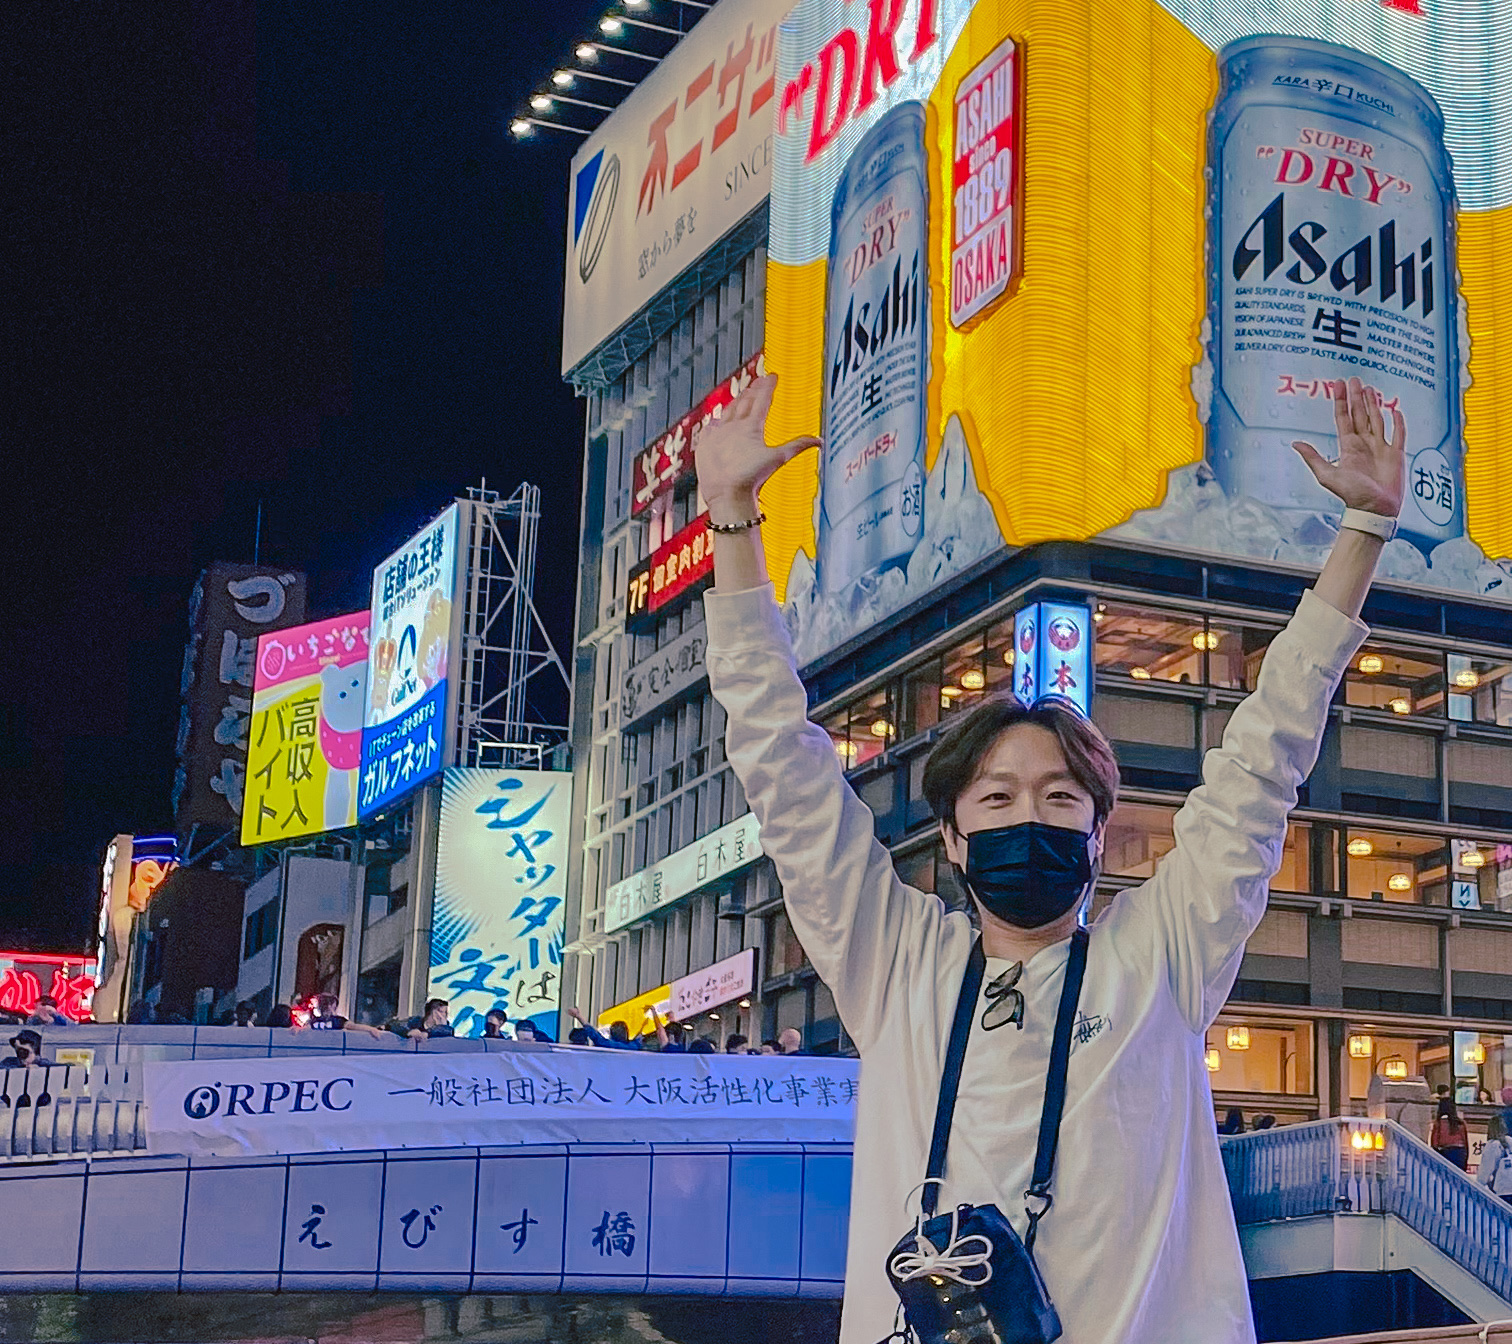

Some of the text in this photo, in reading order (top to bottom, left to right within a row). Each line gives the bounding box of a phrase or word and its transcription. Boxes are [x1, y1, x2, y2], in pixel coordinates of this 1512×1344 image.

[954, 58, 1014, 163] ASAHI
[1272, 74, 1397, 115] KARA 辛口 KUCHI
[969, 134, 997, 175] since
[1298, 126, 1377, 163] SUPER
[862, 196, 895, 233] SUPER
[954, 146, 1013, 246] 1889
[953, 219, 1008, 315] OSAKA
[1232, 192, 1435, 320] Asahi
[832, 248, 920, 398] Asahi
[1279, 289, 1296, 298] DRY
[1307, 292, 1342, 306] BREWED
[1344, 300, 1367, 312] WITH
[1312, 307, 1363, 352] 生
[1366, 319, 1396, 335] UNDER
[1367, 333, 1402, 349] MASTER
[1311, 346, 1338, 361] TASTE
[1338, 353, 1359, 365] AND
[1367, 346, 1386, 359] ING
[860, 373, 884, 418] 生
[844, 429, 899, 484] スーパードライ
[1414, 466, 1454, 511] お酒
[383, 523, 445, 604] 店舗の王様
[629, 570, 650, 615] 7F
[254, 701, 290, 836] バイト
[281, 697, 319, 831] 高収入
[361, 723, 439, 808] ガルフネット
[697, 827, 747, 883] 白木屋
[616, 870, 664, 923] 白木屋
[387, 1074, 612, 1108] 一般社団法人
[298, 1203, 636, 1258] えびす橋
